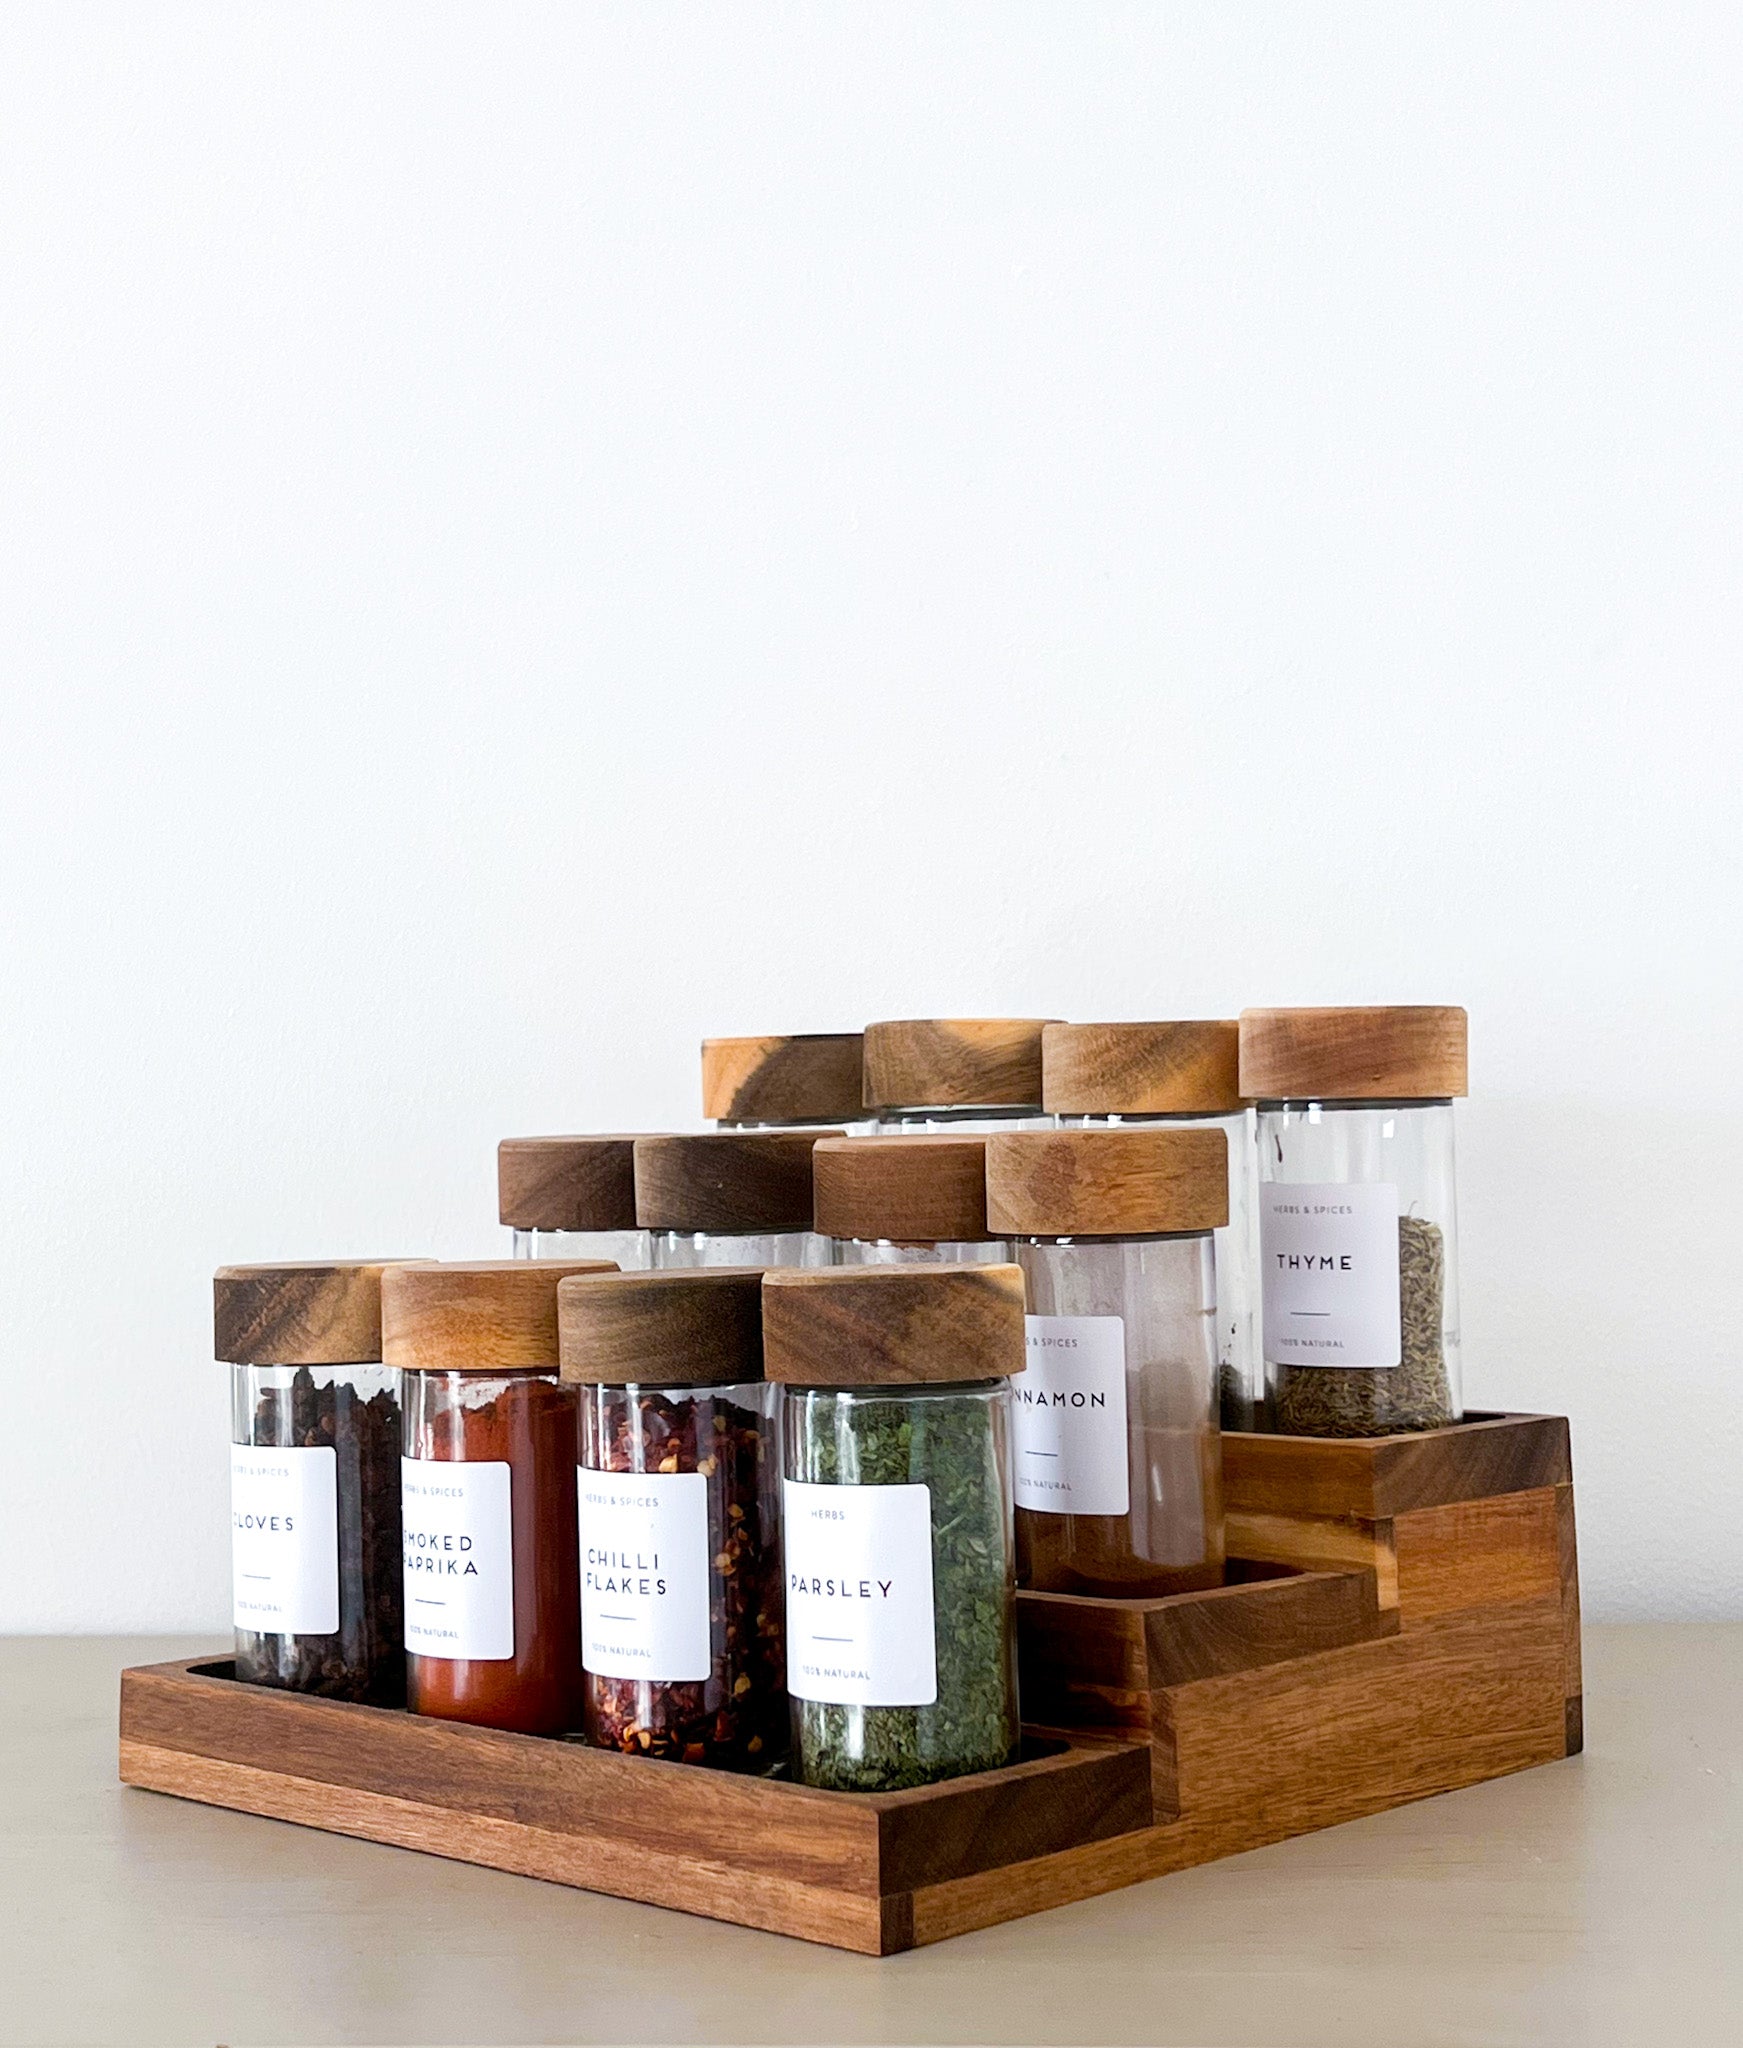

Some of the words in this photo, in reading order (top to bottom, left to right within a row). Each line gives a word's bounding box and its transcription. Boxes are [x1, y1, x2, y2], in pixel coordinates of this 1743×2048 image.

[1313, 1205, 1353, 1215] SPICES
[1276, 1254, 1352, 1271] THYME
[1041, 1337, 1078, 1348] SPICES
[1301, 1338, 1345, 1349] NATURAL
[430, 1486, 464, 1498] SPICES
[1033, 1480, 1073, 1492] NATURAL
[619, 1496, 660, 1508] SPICES
[811, 1509, 846, 1521] HERBS
[588, 1548, 659, 1571] CHILLI
[586, 1572, 667, 1596] FLAKES
[791, 1573, 893, 1599] PARSLEY
[423, 1627, 460, 1640] NATURAL
[609, 1645, 652, 1659] NATURAL
[824, 1668, 872, 1681] NATURAL
